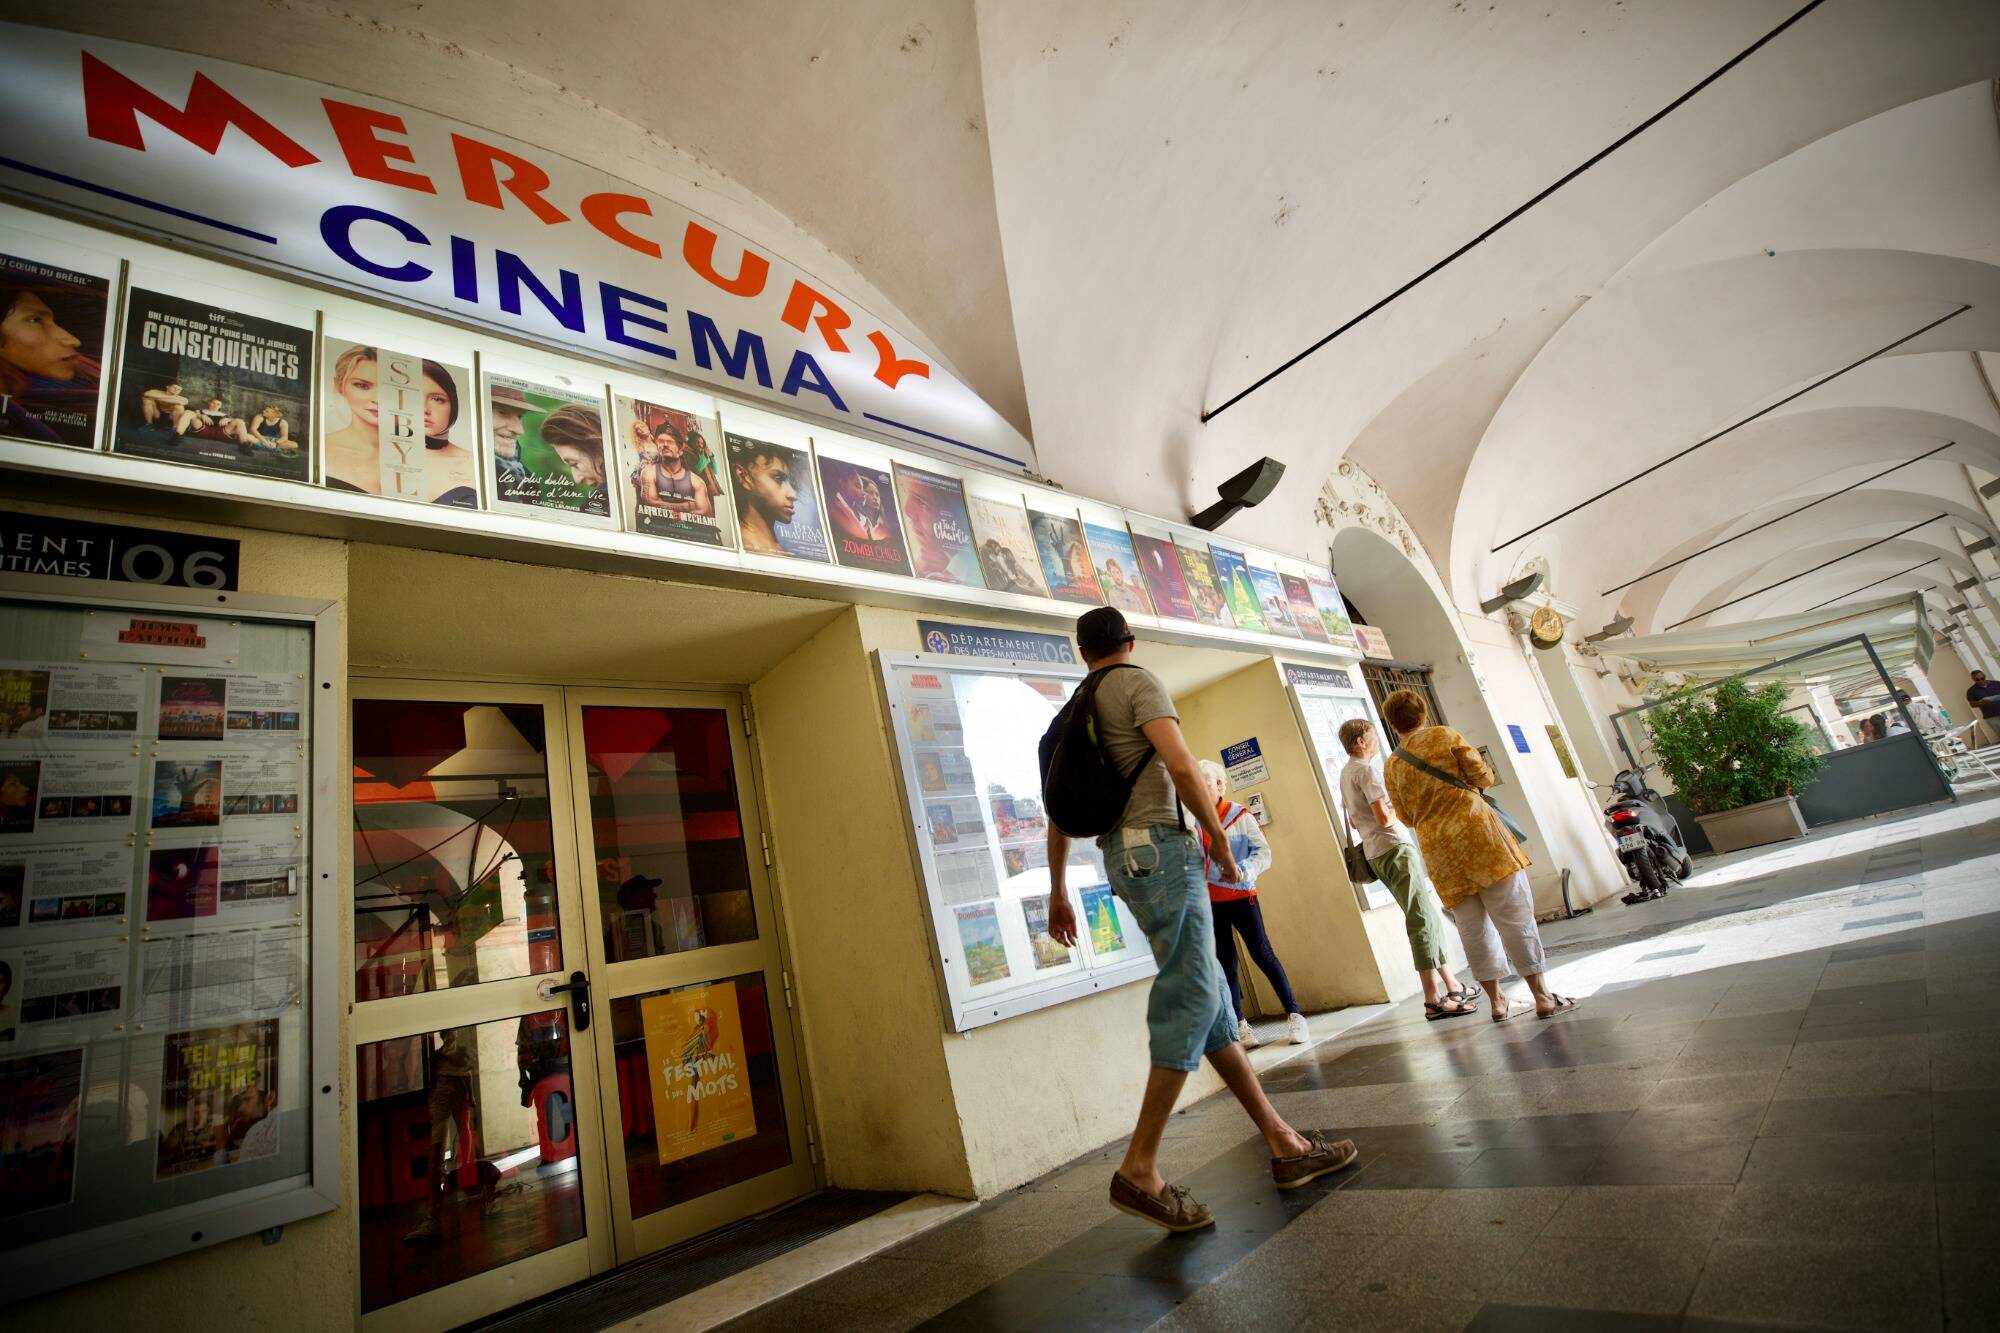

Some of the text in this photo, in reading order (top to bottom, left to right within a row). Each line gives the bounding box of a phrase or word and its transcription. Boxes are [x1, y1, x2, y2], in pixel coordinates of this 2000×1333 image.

[82, 49, 929, 390] MERCURY
[40, 267, 54, 278] DU
[320, 205, 850, 413] CINEMA
[148, 310, 162, 321] UNE
[189, 319, 209, 331] COUP
[209, 325, 219, 334] DE
[219, 327, 241, 339] POING
[242, 332, 256, 345] SUR
[257, 336, 265, 345] LA
[266, 338, 297, 352] JEUNESSE
[142, 320, 299, 380] CONSEQUENCES
[933, 521, 970, 544] Charlie
[121, 544, 227, 590] 06
[951, 632, 1035, 651] DÉPARTEMENT
[181, 1044, 213, 1067] TEL
[663, 1053, 736, 1086] FESTIVAL
[192, 1067, 257, 1092] ON FIRE
[686, 1073, 739, 1104] MOTS
